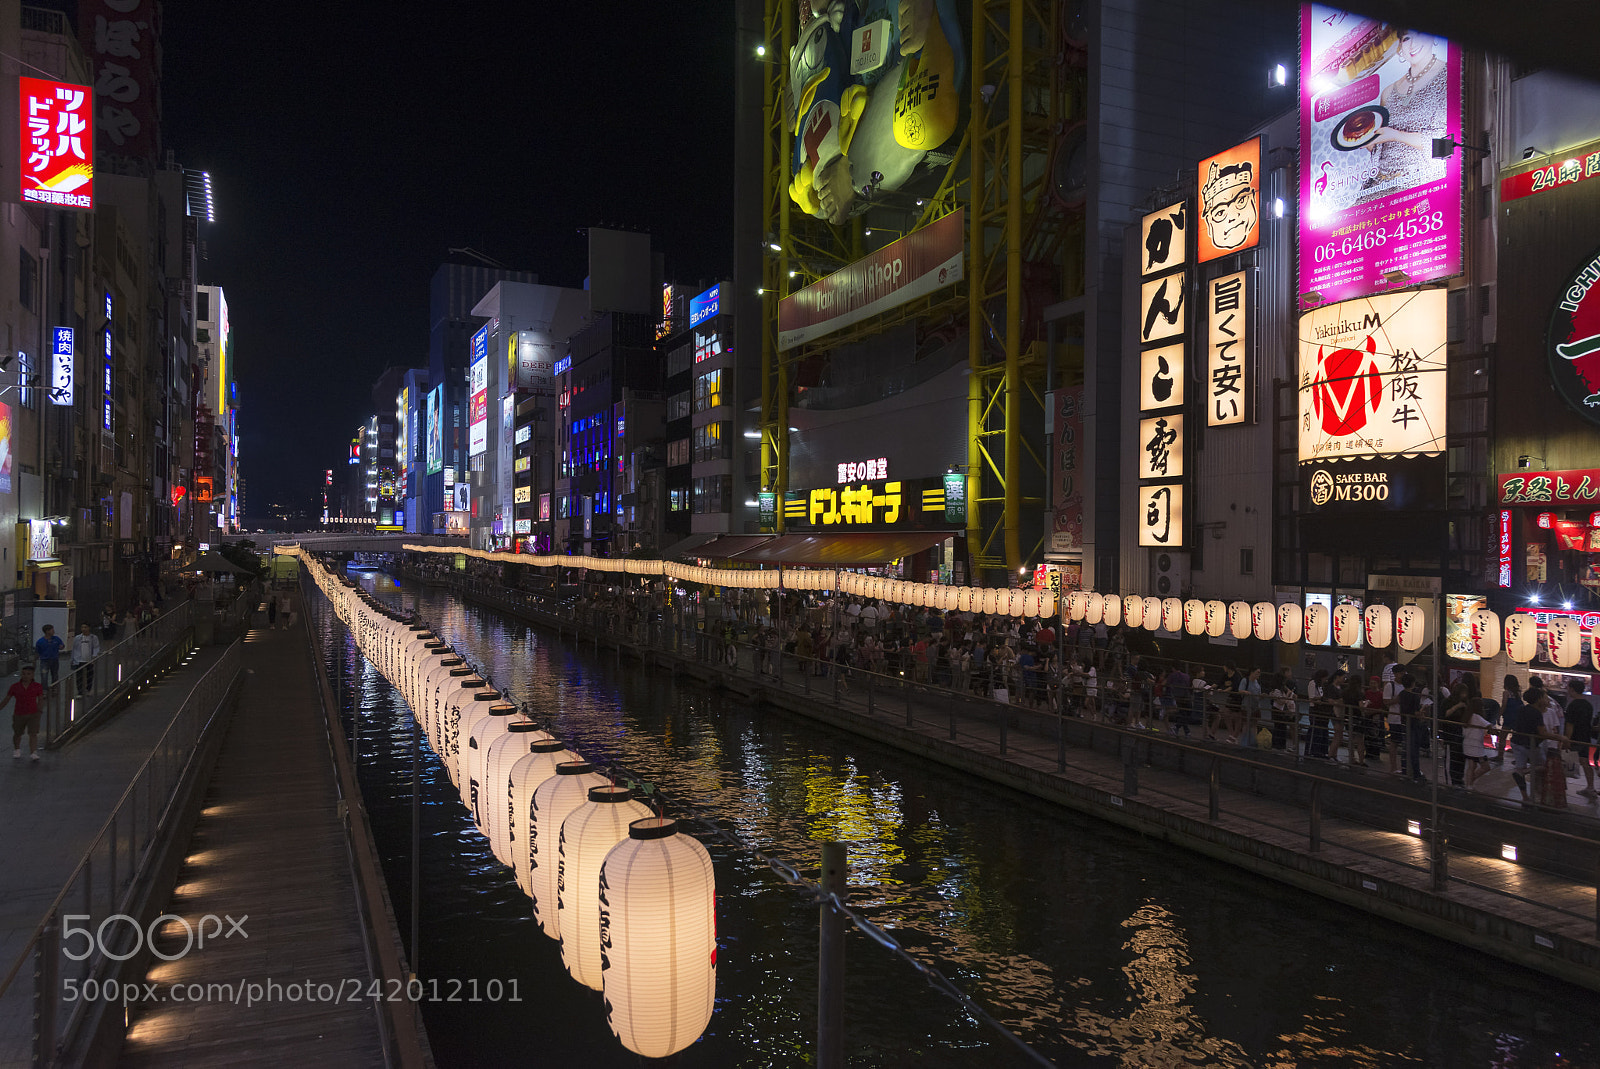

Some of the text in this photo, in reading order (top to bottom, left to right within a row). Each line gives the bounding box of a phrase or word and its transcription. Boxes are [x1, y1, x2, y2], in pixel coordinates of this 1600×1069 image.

[28, 95, 54, 172] ドラッグ
[56, 87, 86, 160] ツルハ
[1314, 211, 1444, 263] 06-6468-4538
[1315, 312, 1381, 340] Yakiniku M
[58, 329, 72, 354] 焼肉
[1211, 277, 1242, 422] 旨くて安い
[521, 361, 552, 370] DEEP
[1390, 347, 1423, 431] 松阪牛
[1334, 484, 1389, 502] M300
[1336, 472, 1388, 484] SAKE BAR
[1502, 474, 1600, 504] 天然とん
